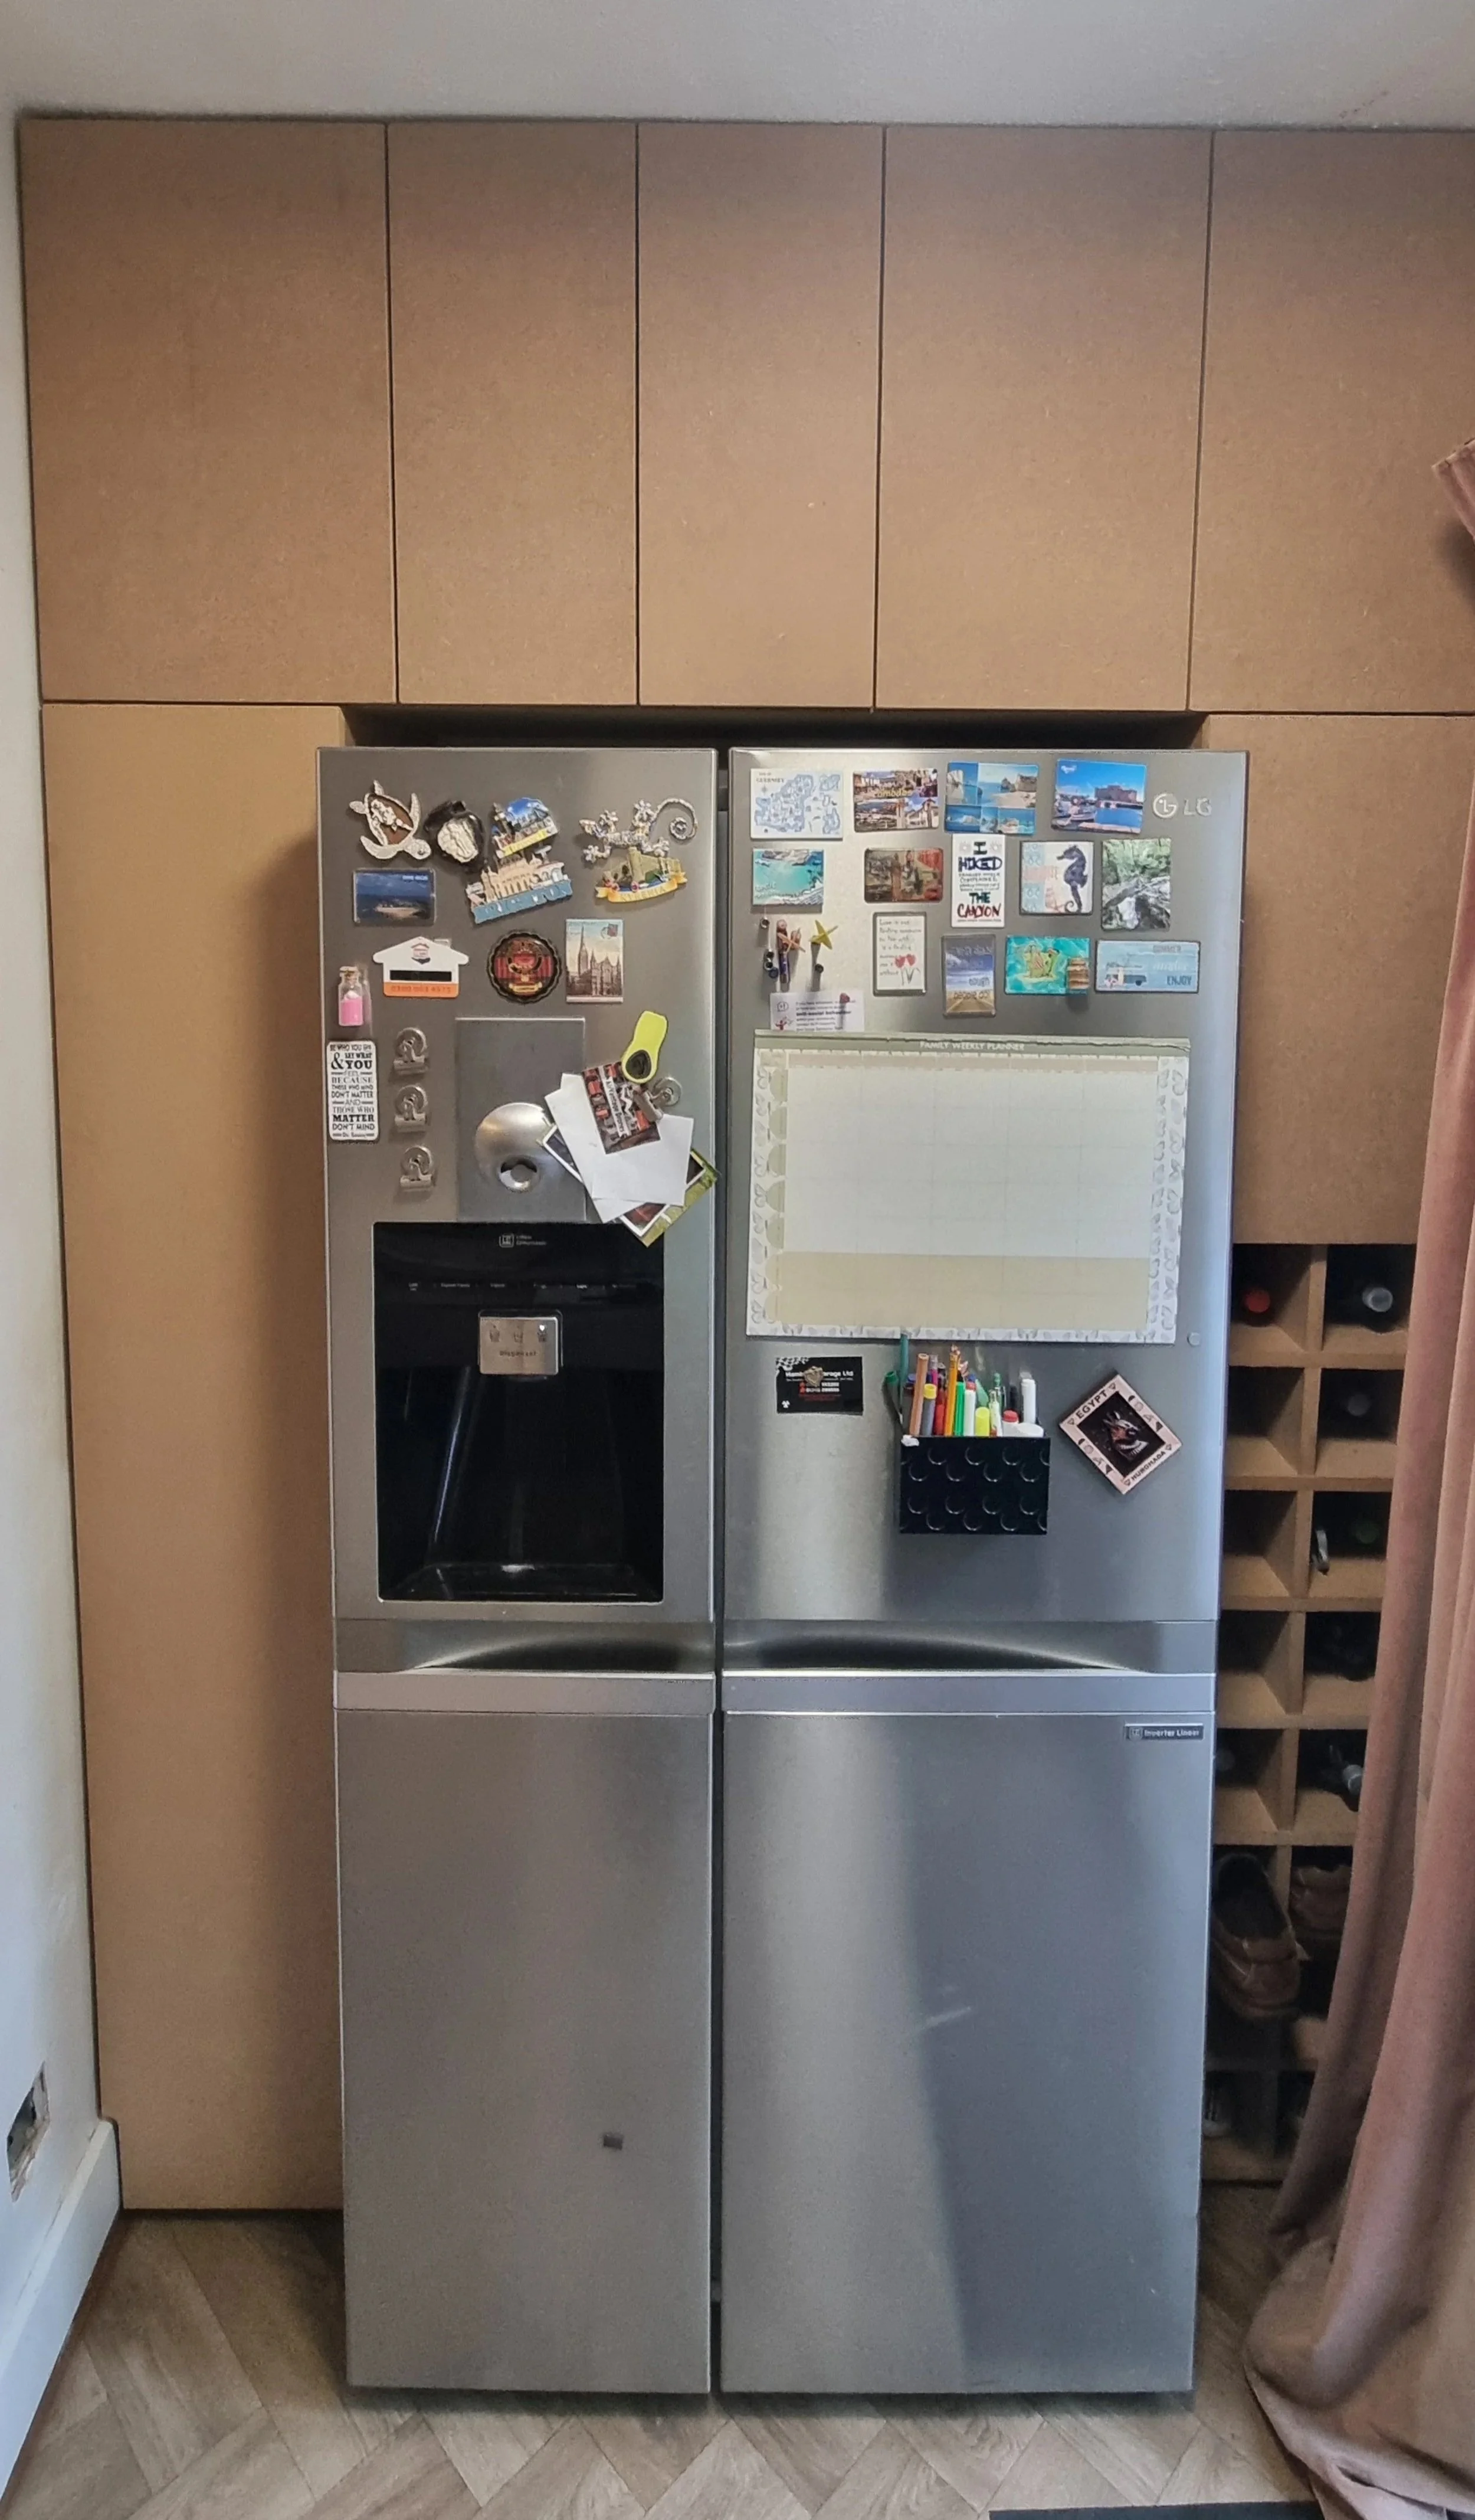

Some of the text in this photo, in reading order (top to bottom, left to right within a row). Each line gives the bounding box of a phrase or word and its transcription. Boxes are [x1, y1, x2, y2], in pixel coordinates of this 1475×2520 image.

[1184, 798, 1212, 817] LG
[974, 842, 988, 855] I
[958, 856, 1002, 872] HIKED
[969, 892, 991, 904] THE
[957, 903, 1001, 918] CANYON
[1167, 976, 1192, 986] ENJOY
[345, 1060, 372, 1069] YOU
[1076, 1389, 1108, 1419] EGYPT
[1132, 1451, 1166, 1481] HURGHADA
